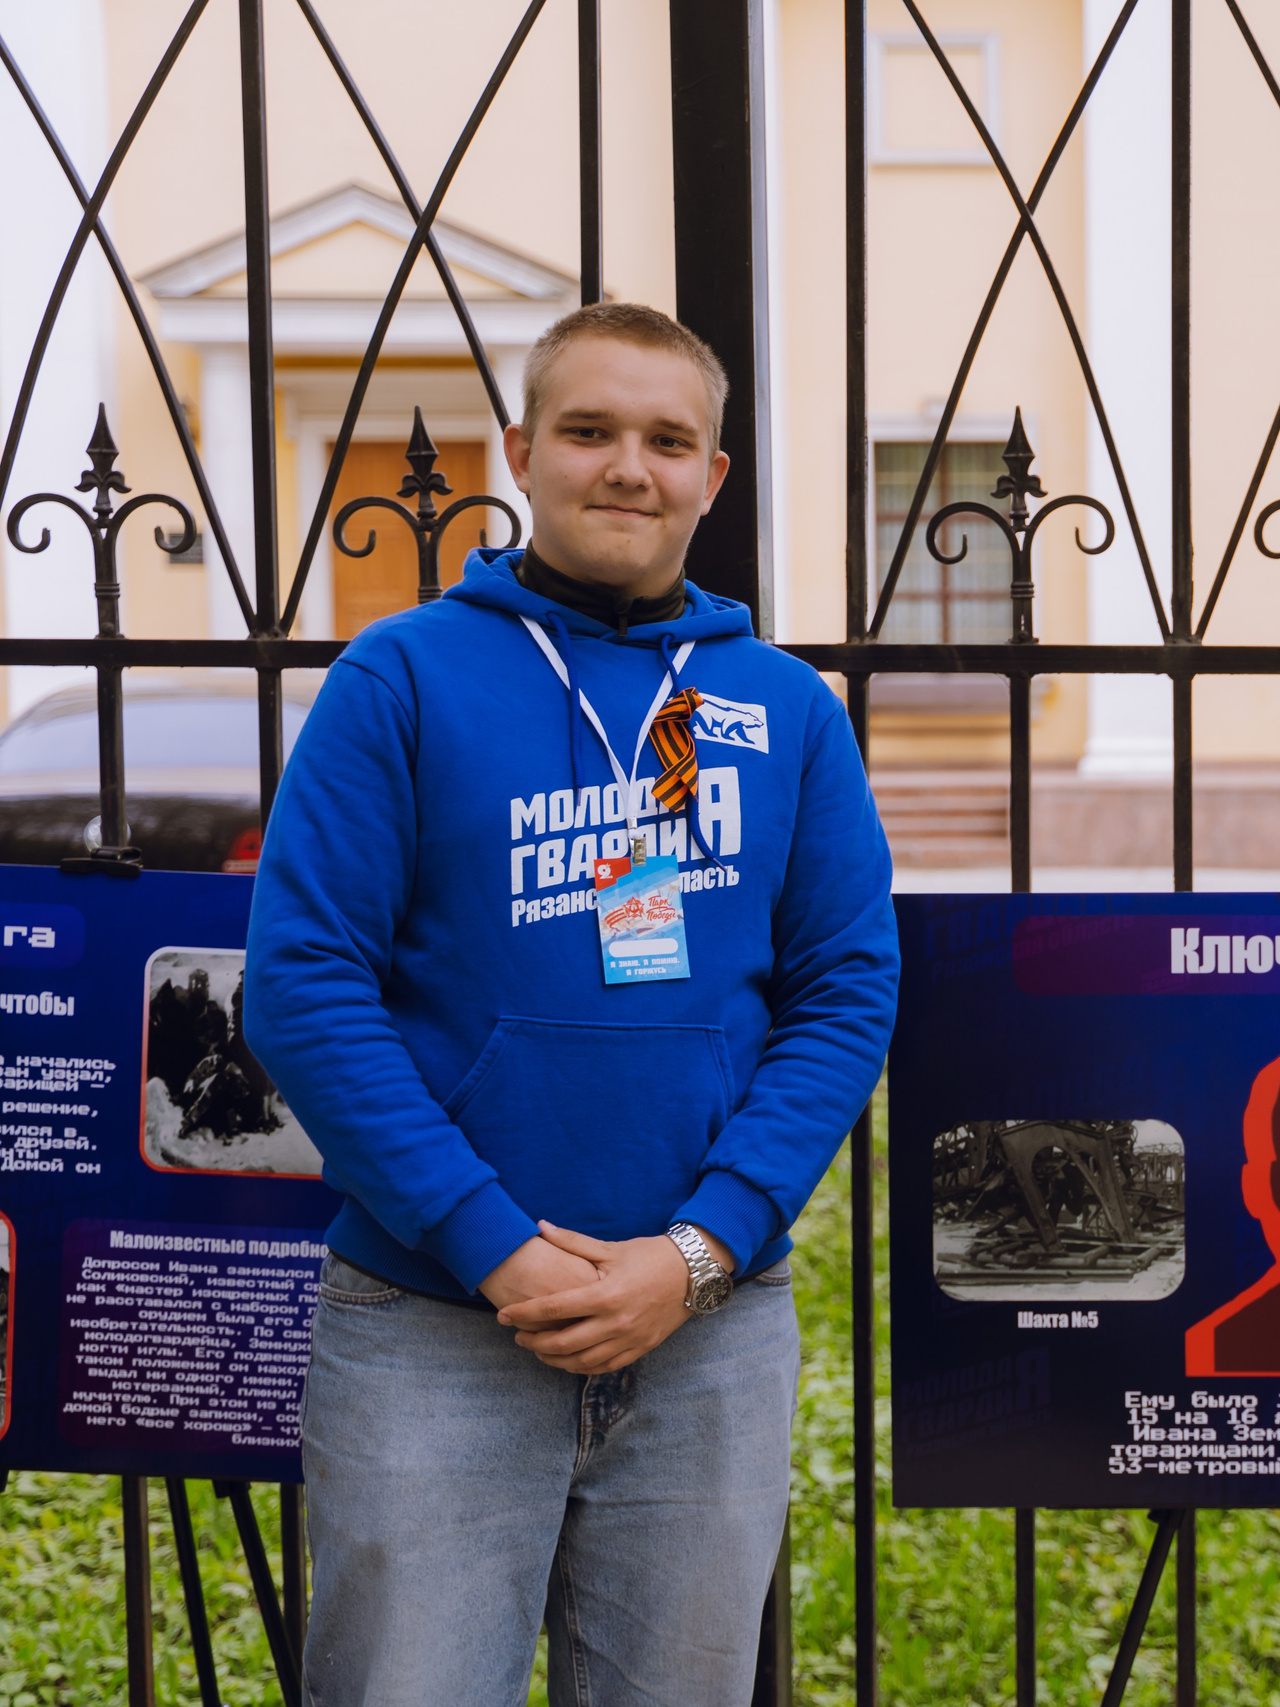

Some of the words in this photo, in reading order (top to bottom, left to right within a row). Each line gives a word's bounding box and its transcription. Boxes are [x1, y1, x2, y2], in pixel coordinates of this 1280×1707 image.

[512, 888, 598, 928] Рязанс
[679, 865, 740, 892] ласть
[648, 895, 672, 907] Парк
[0, 991, 75, 1016] чтобы
[16, 1056, 116, 1070] начались
[41, 1068, 112, 1083] узнал,
[0, 1078, 79, 1092] арищей
[2, 1101, 98, 1117] решение,
[0, 1124, 53, 1137] ился
[64, 1127, 77, 1138] в
[14, 1136, 97, 1150] друзей.
[0, 1147, 39, 1159] нты
[1, 1157, 64, 1172] Домой
[75, 1162, 101, 1174] он
[110, 1230, 246, 1254] Малоизвестные
[82, 1256, 160, 1271] Допросом
[168, 1261, 218, 1274] Ивана
[226, 1266, 315, 1279] занимался
[81, 1268, 195, 1286] Соликовский,
[206, 1277, 295, 1290] известный
[76, 1282, 106, 1292] как
[115, 1283, 184, 1297] «мастер
[192, 1288, 289, 1302] изощренных
[66, 1294, 86, 1304] не
[95, 1295, 202, 1309] расставался
[211, 1301, 221, 1310] с
[230, 1301, 299, 1314] набором
[138, 1310, 207, 1322] орудием
[215, 1311, 255, 1324] была
[264, 1316, 294, 1326] его
[1018, 1311, 1069, 1328] Шахта
[1071, 1311, 1099, 1328] №5
[70, 1318, 242, 1336] изобретательность.
[253, 1326, 274, 1337] По
[84, 1331, 236, 1349] молодогвардейца,
[79, 1343, 129, 1354] ногти
[137, 1346, 183, 1357] иглы.
[195, 1347, 225, 1359] Его
[75, 1354, 123, 1366] таком
[132, 1358, 220, 1371] положении
[229, 1363, 249, 1373] он
[88, 1367, 137, 1379] выдал
[146, 1371, 166, 1380] ни
[175, 1372, 234, 1384] одного
[243, 1376, 298, 1387] имени.
[112, 1381, 225, 1396] истерзанный,
[237, 1387, 297, 1400] плюнул
[73, 1391, 157, 1403] мучителю.
[169, 1394, 200, 1406] При
[208, 1398, 248, 1408] этом
[256, 1401, 276, 1410] из
[1124, 1391, 1175, 1410] Ему
[1191, 1391, 1258, 1408] было
[63, 1402, 112, 1414] домой
[121, 1403, 180, 1417] бодрые
[189, 1409, 263, 1423] записки,
[1127, 1408, 1159, 1425] 15
[1174, 1411, 1208, 1425] на
[1227, 1408, 1258, 1425] 16
[86, 1416, 126, 1427] него
[184, 1421, 252, 1432] хорошо»
[1133, 1424, 1217, 1441] Ивана
[231, 1433, 300, 1447] близких
[1111, 1444, 1275, 1459] товарищами
